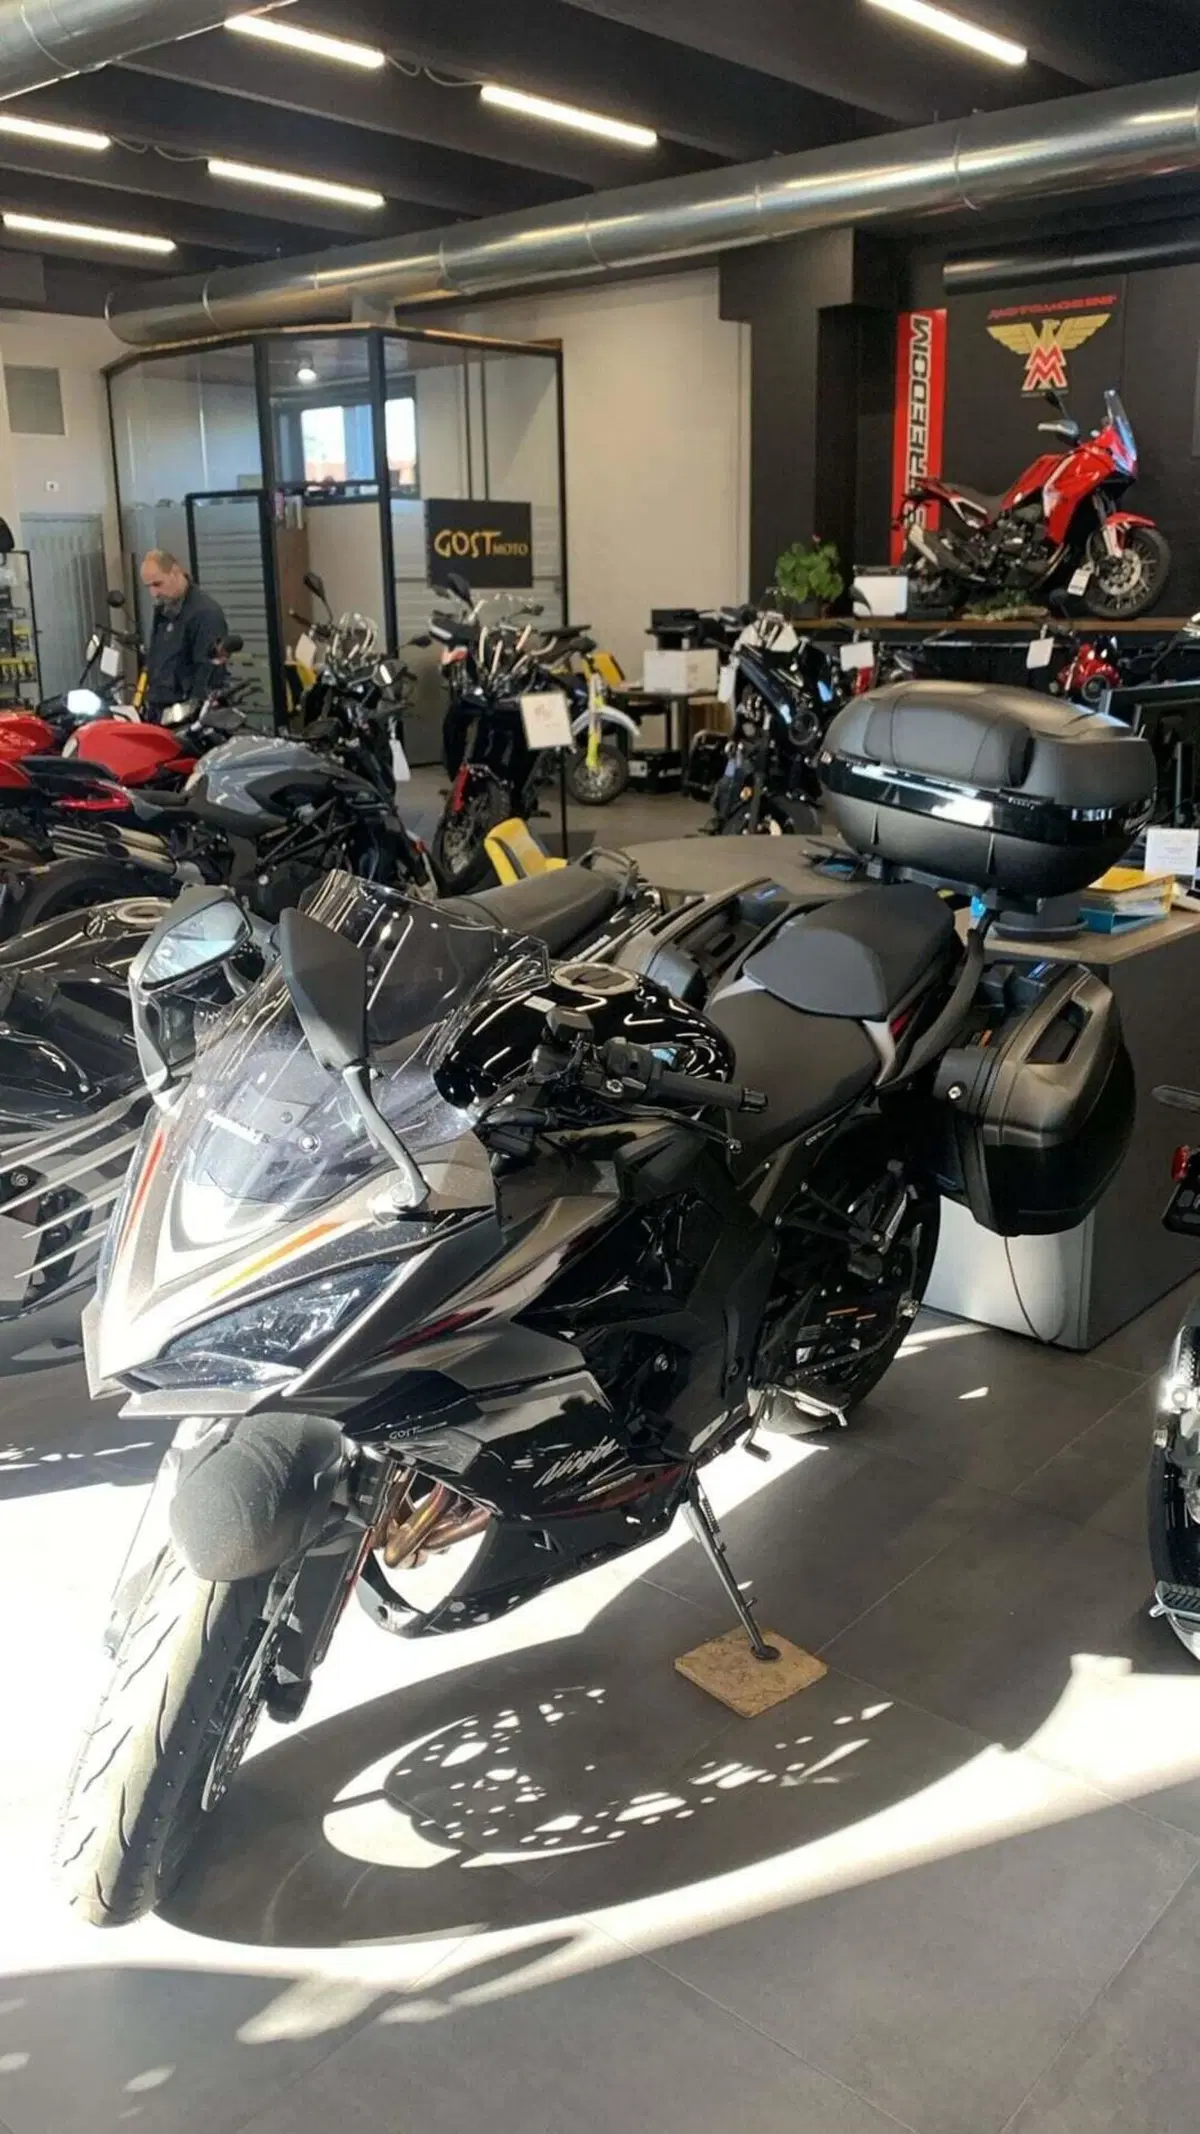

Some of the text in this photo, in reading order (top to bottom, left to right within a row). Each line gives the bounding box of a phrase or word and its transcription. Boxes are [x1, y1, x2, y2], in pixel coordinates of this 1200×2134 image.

[433, 529, 529, 558] GOST MOTO
[532, 1435, 620, 1489] Ninja
